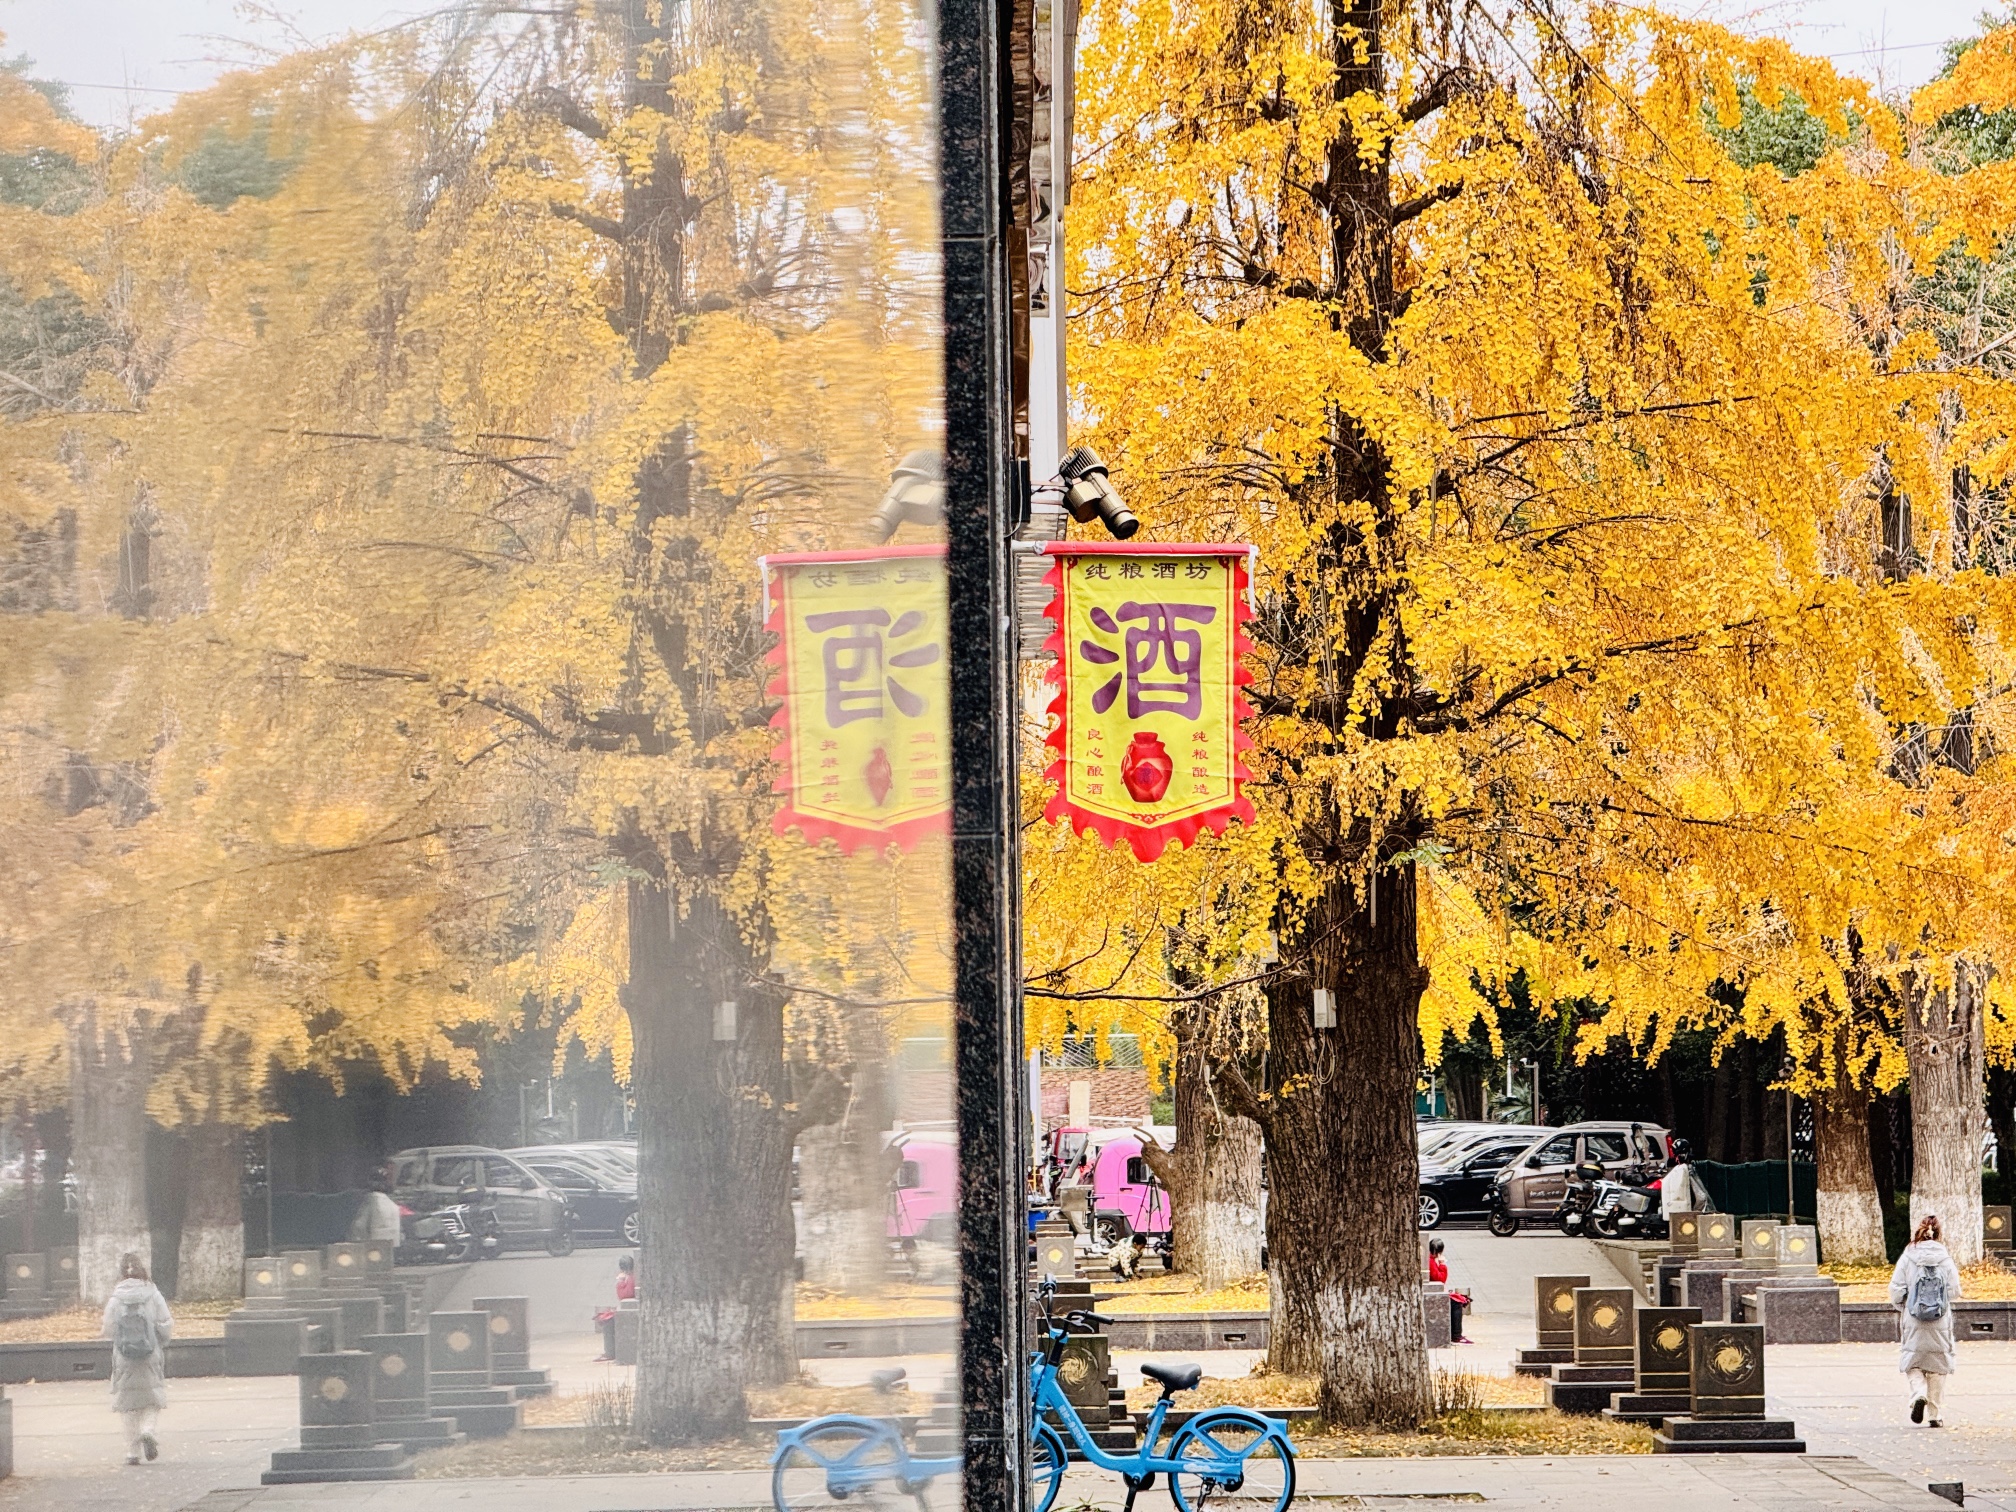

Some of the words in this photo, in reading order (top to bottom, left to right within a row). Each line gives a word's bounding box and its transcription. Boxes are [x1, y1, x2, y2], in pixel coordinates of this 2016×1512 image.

[1084, 562, 1212, 580] 纯粮酒坊
[1080, 601, 1217, 721] 酒
[1086, 728, 1104, 795] 良心酿酒
[1191, 730, 1210, 796] 纯粮酿造
